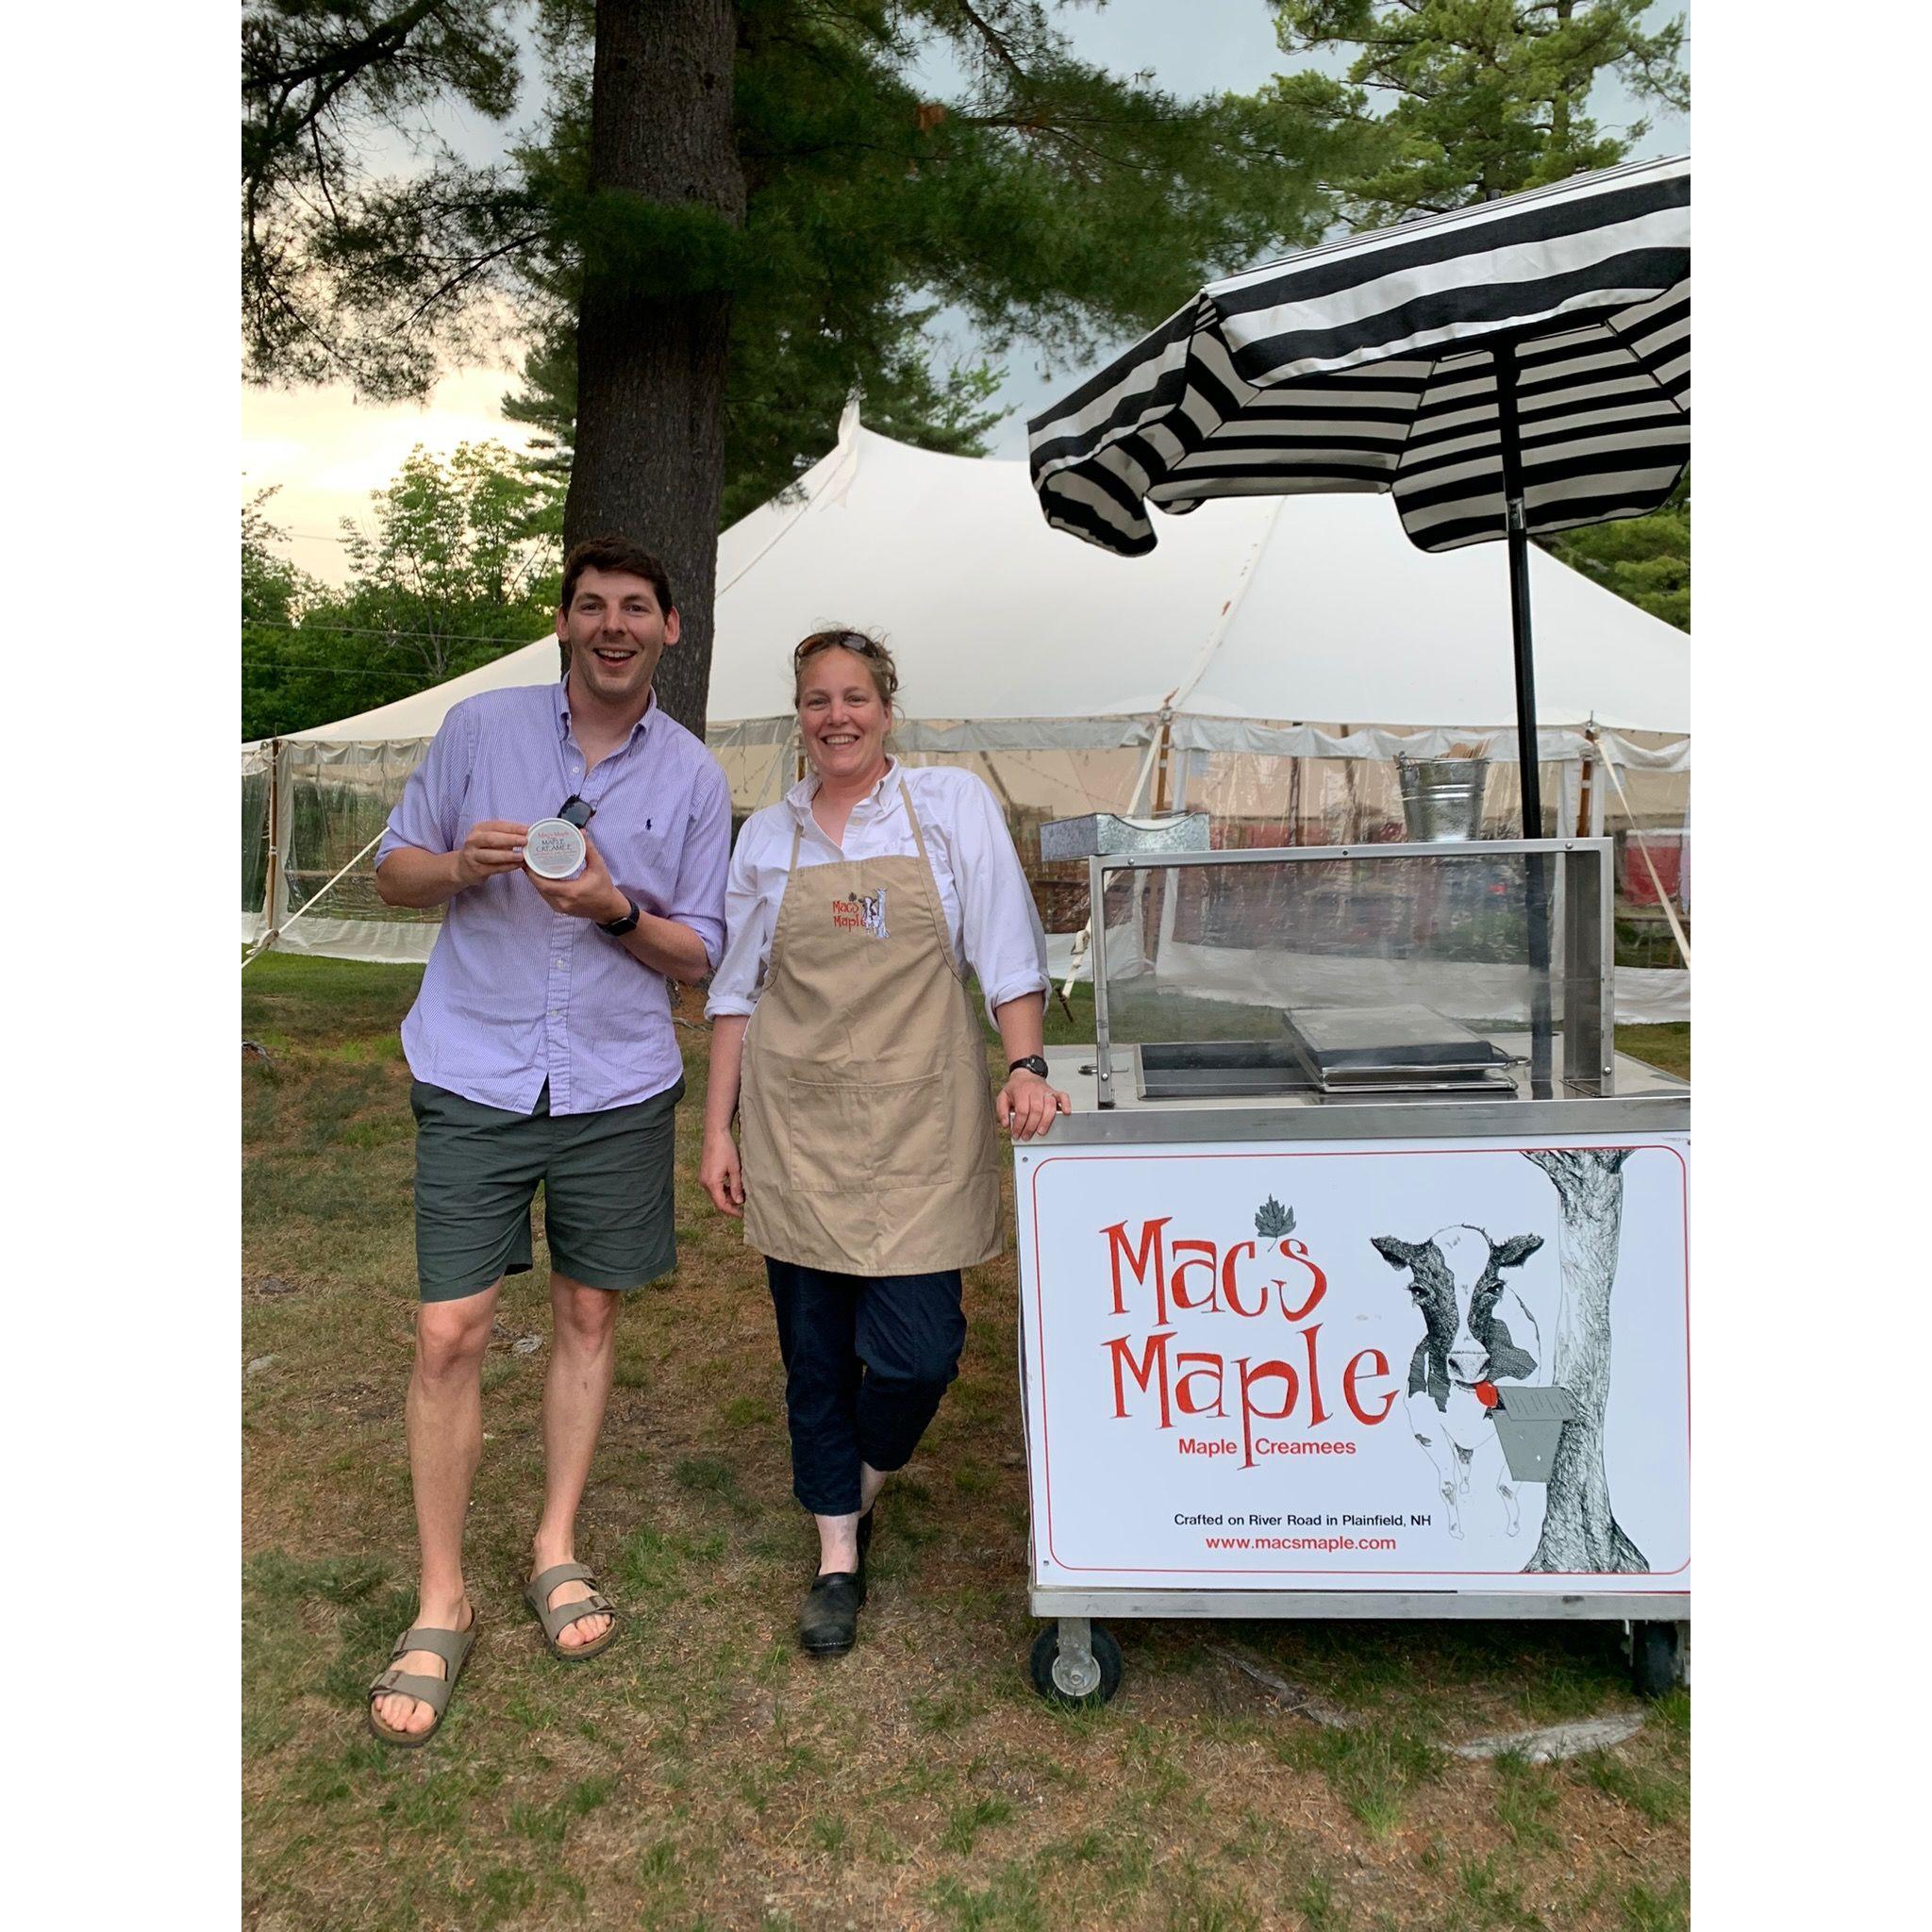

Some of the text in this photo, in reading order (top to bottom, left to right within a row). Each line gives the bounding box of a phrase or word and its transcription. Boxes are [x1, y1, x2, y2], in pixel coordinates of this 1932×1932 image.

[833, 914, 867, 932] Maple
[1101, 1323, 1400, 1470] Maple
[1177, 1438, 1357, 1457] Maple Creamees
[1174, 1513, 1432, 1528] Crafted on River Road in Plainfield, NH
[1205, 1536, 1396, 1553] www.macsmaple.com
